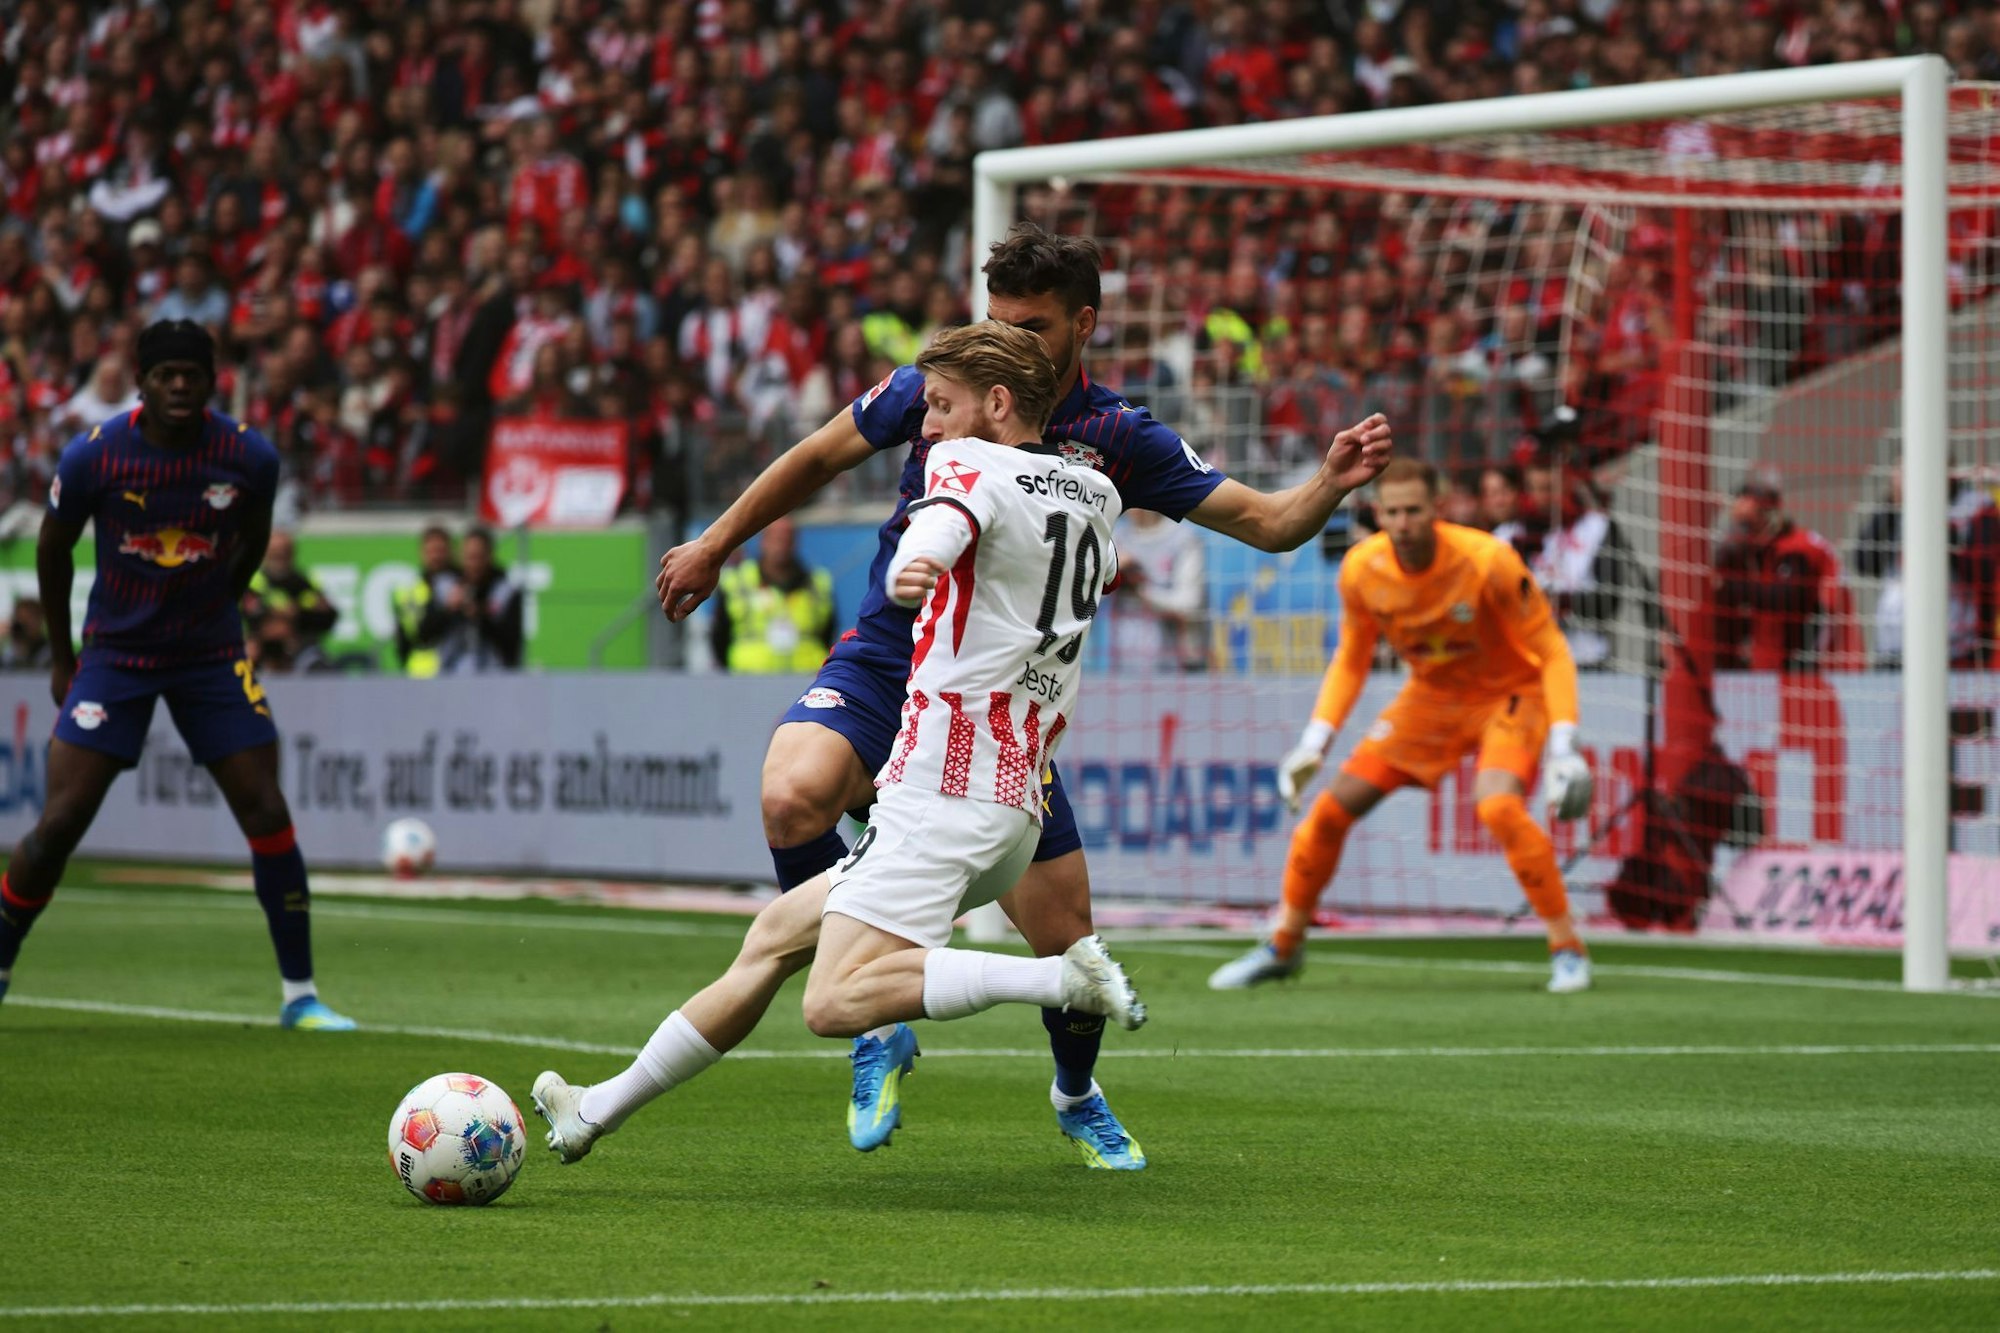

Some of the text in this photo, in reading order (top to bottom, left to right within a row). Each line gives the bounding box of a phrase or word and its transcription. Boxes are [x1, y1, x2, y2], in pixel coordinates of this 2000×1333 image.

[385, 730, 438, 812] auf
[445, 730, 498, 812] die
[505, 752, 544, 812] es
